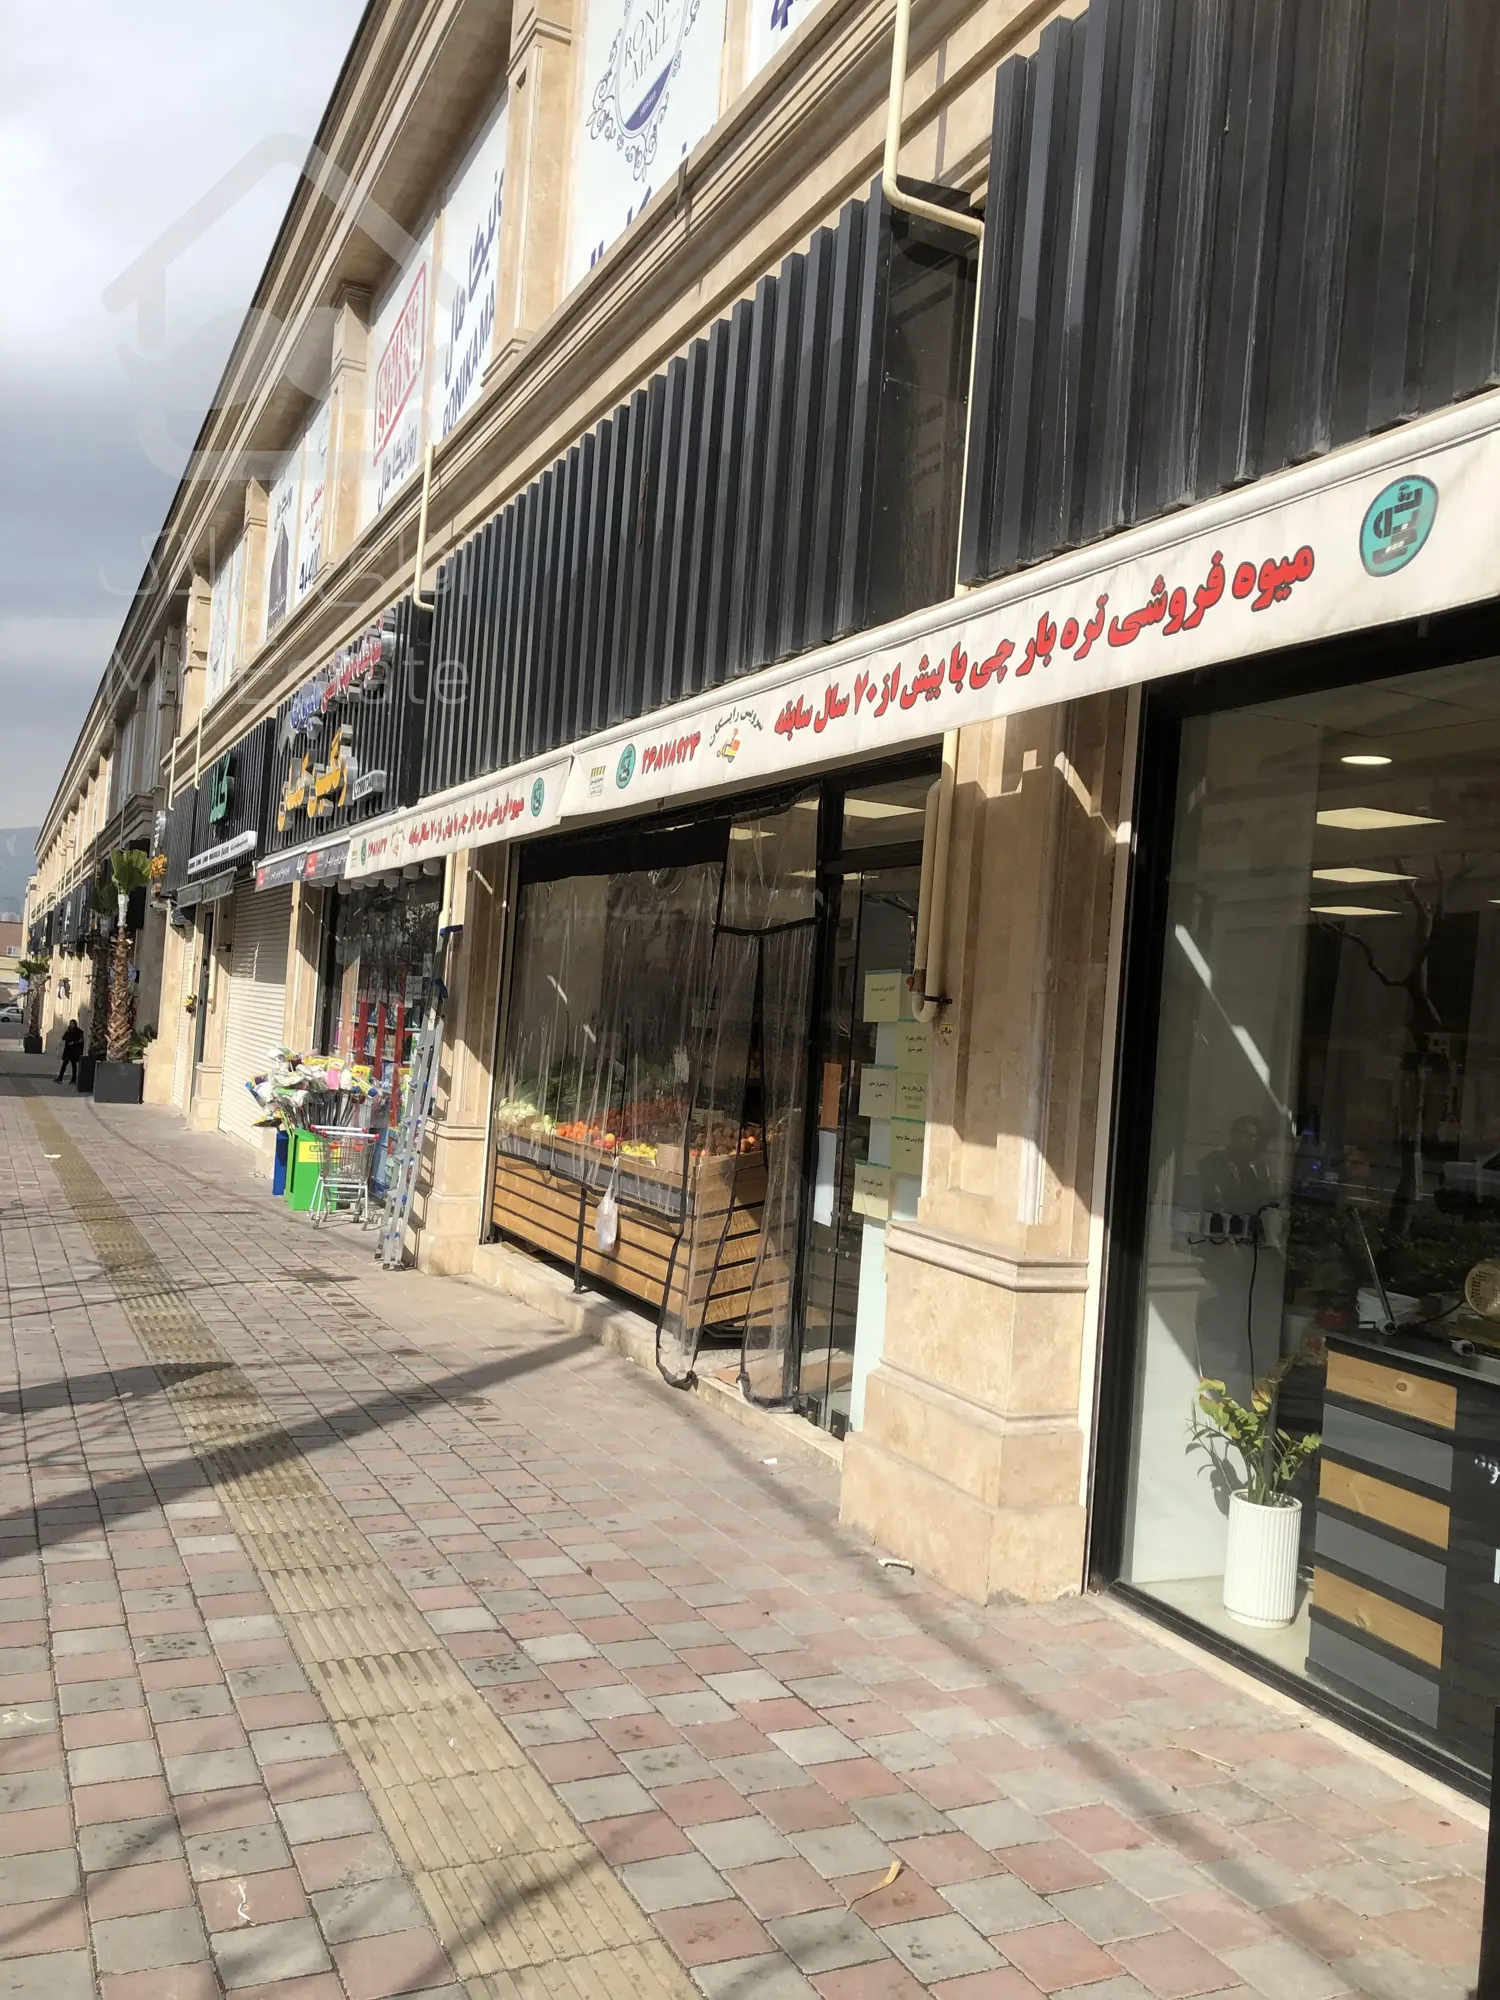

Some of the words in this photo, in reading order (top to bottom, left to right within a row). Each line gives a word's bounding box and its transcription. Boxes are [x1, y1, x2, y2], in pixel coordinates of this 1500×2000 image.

[624, 0, 670, 68] RONI
[632, 15, 670, 88] MALL
[377, 290, 420, 403] COMING
[392, 422, 418, 480] رونیکا
[377, 454, 392, 513] مال
[1107, 550, 1227, 647] فروشی
[1231, 545, 1315, 612] میوه
[873, 661, 902, 718] از
[900, 653, 946, 710] بیش
[948, 641, 968, 694] با
[740, 708, 764, 732] سرویس
[773, 693, 814, 742] سابقه
[813, 682, 851, 734] سال
